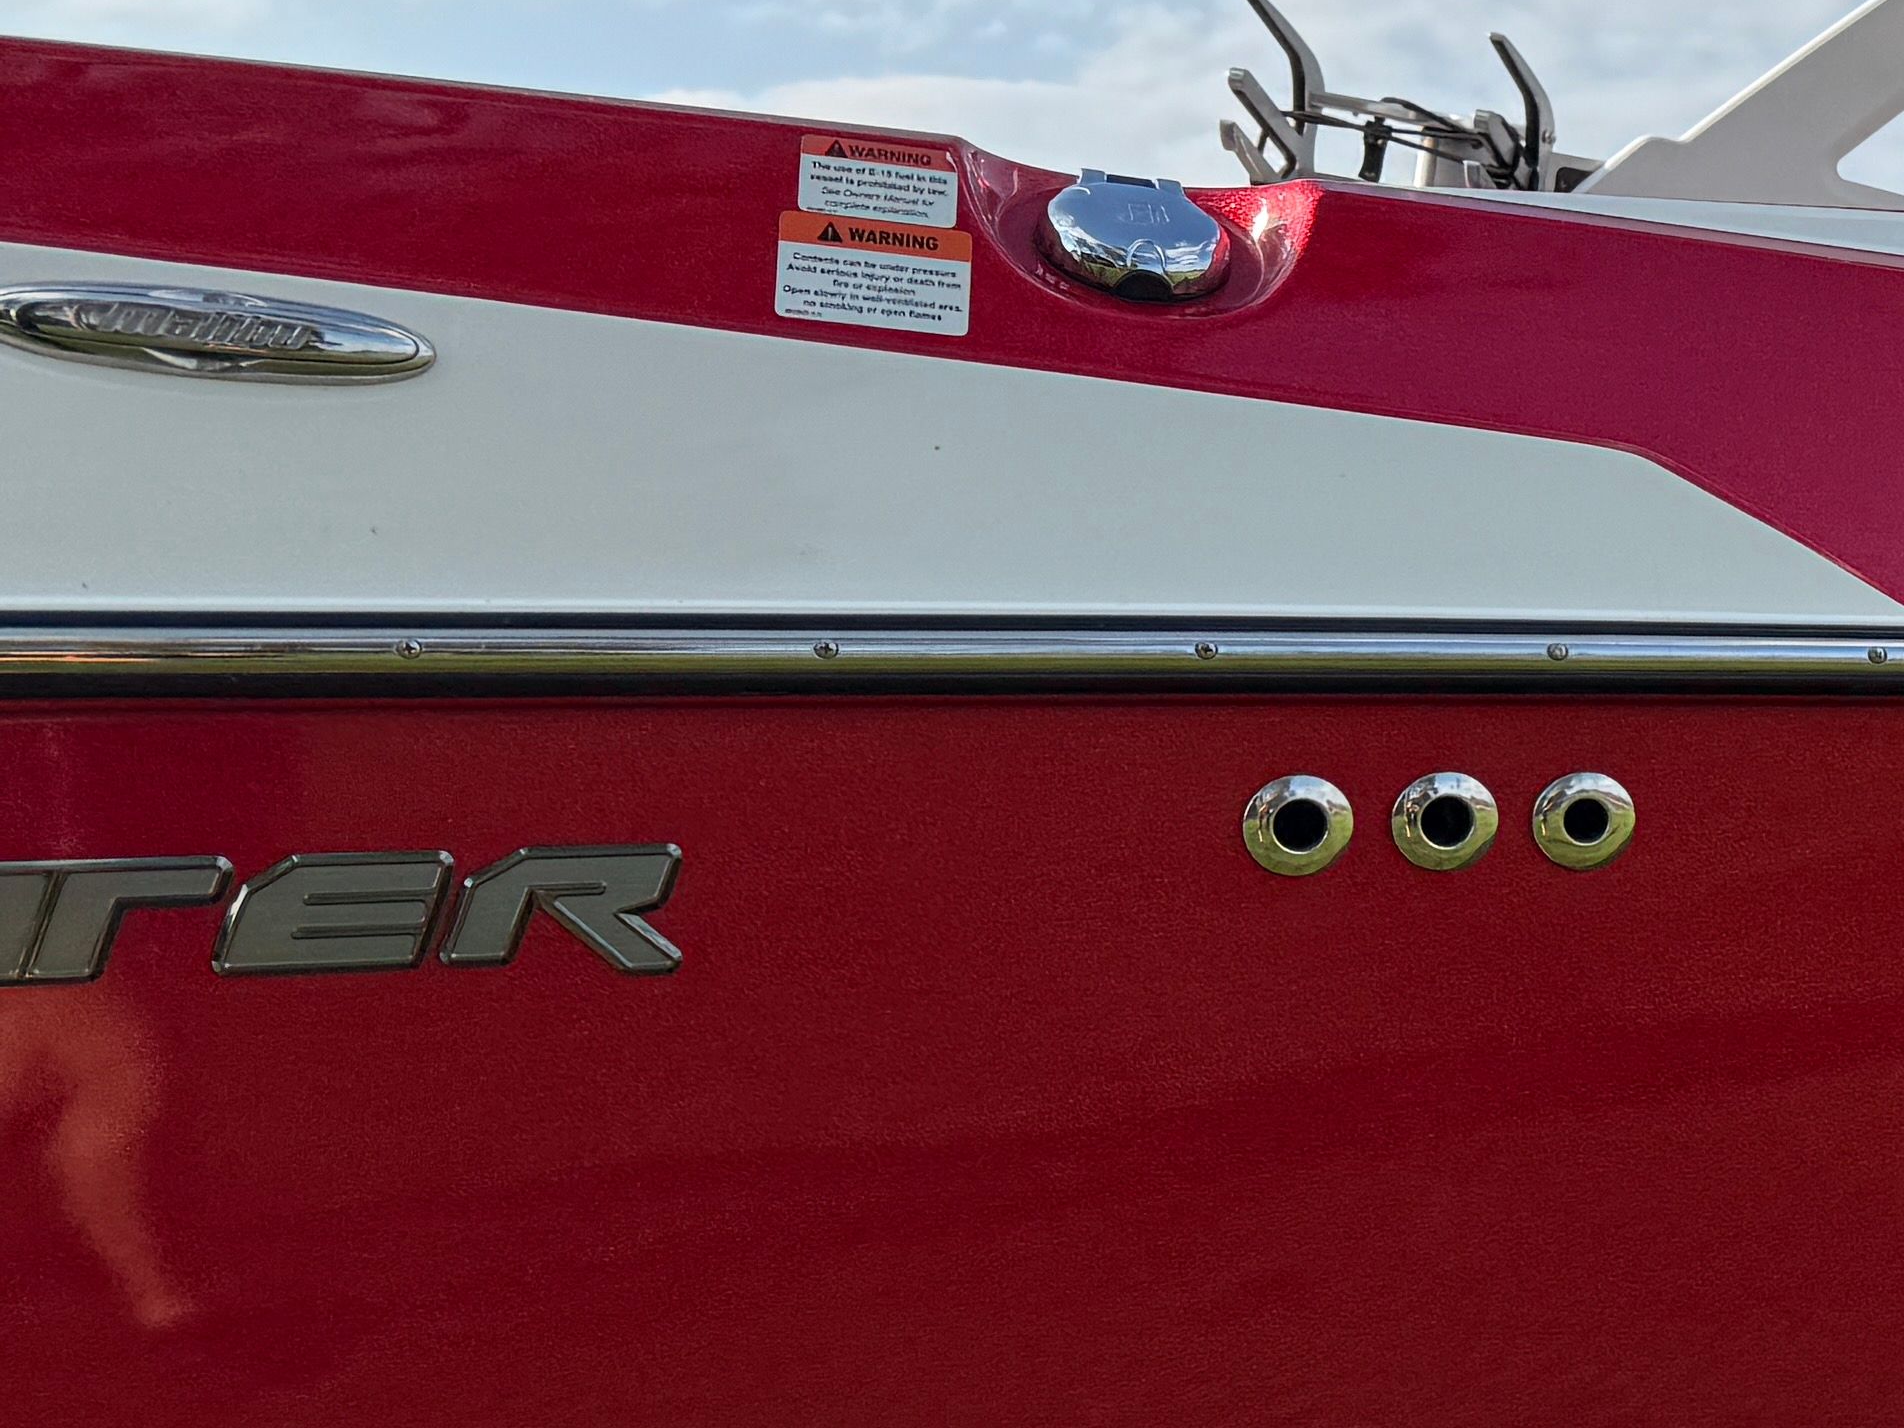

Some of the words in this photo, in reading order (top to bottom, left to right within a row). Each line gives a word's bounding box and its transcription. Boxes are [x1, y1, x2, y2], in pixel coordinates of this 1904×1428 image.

[848, 145, 932, 166] WARNING
[811, 160, 831, 171] The
[895, 171, 914, 181] fuel
[912, 185, 925, 195] by
[848, 227, 940, 251] WARNING
[786, 263, 817, 273] Avoid
[861, 271, 890, 283] injury
[906, 276, 936, 287] death
[783, 284, 811, 295] Open
[813, 289, 847, 300] slowly
[819, 301, 864, 314] smoking
